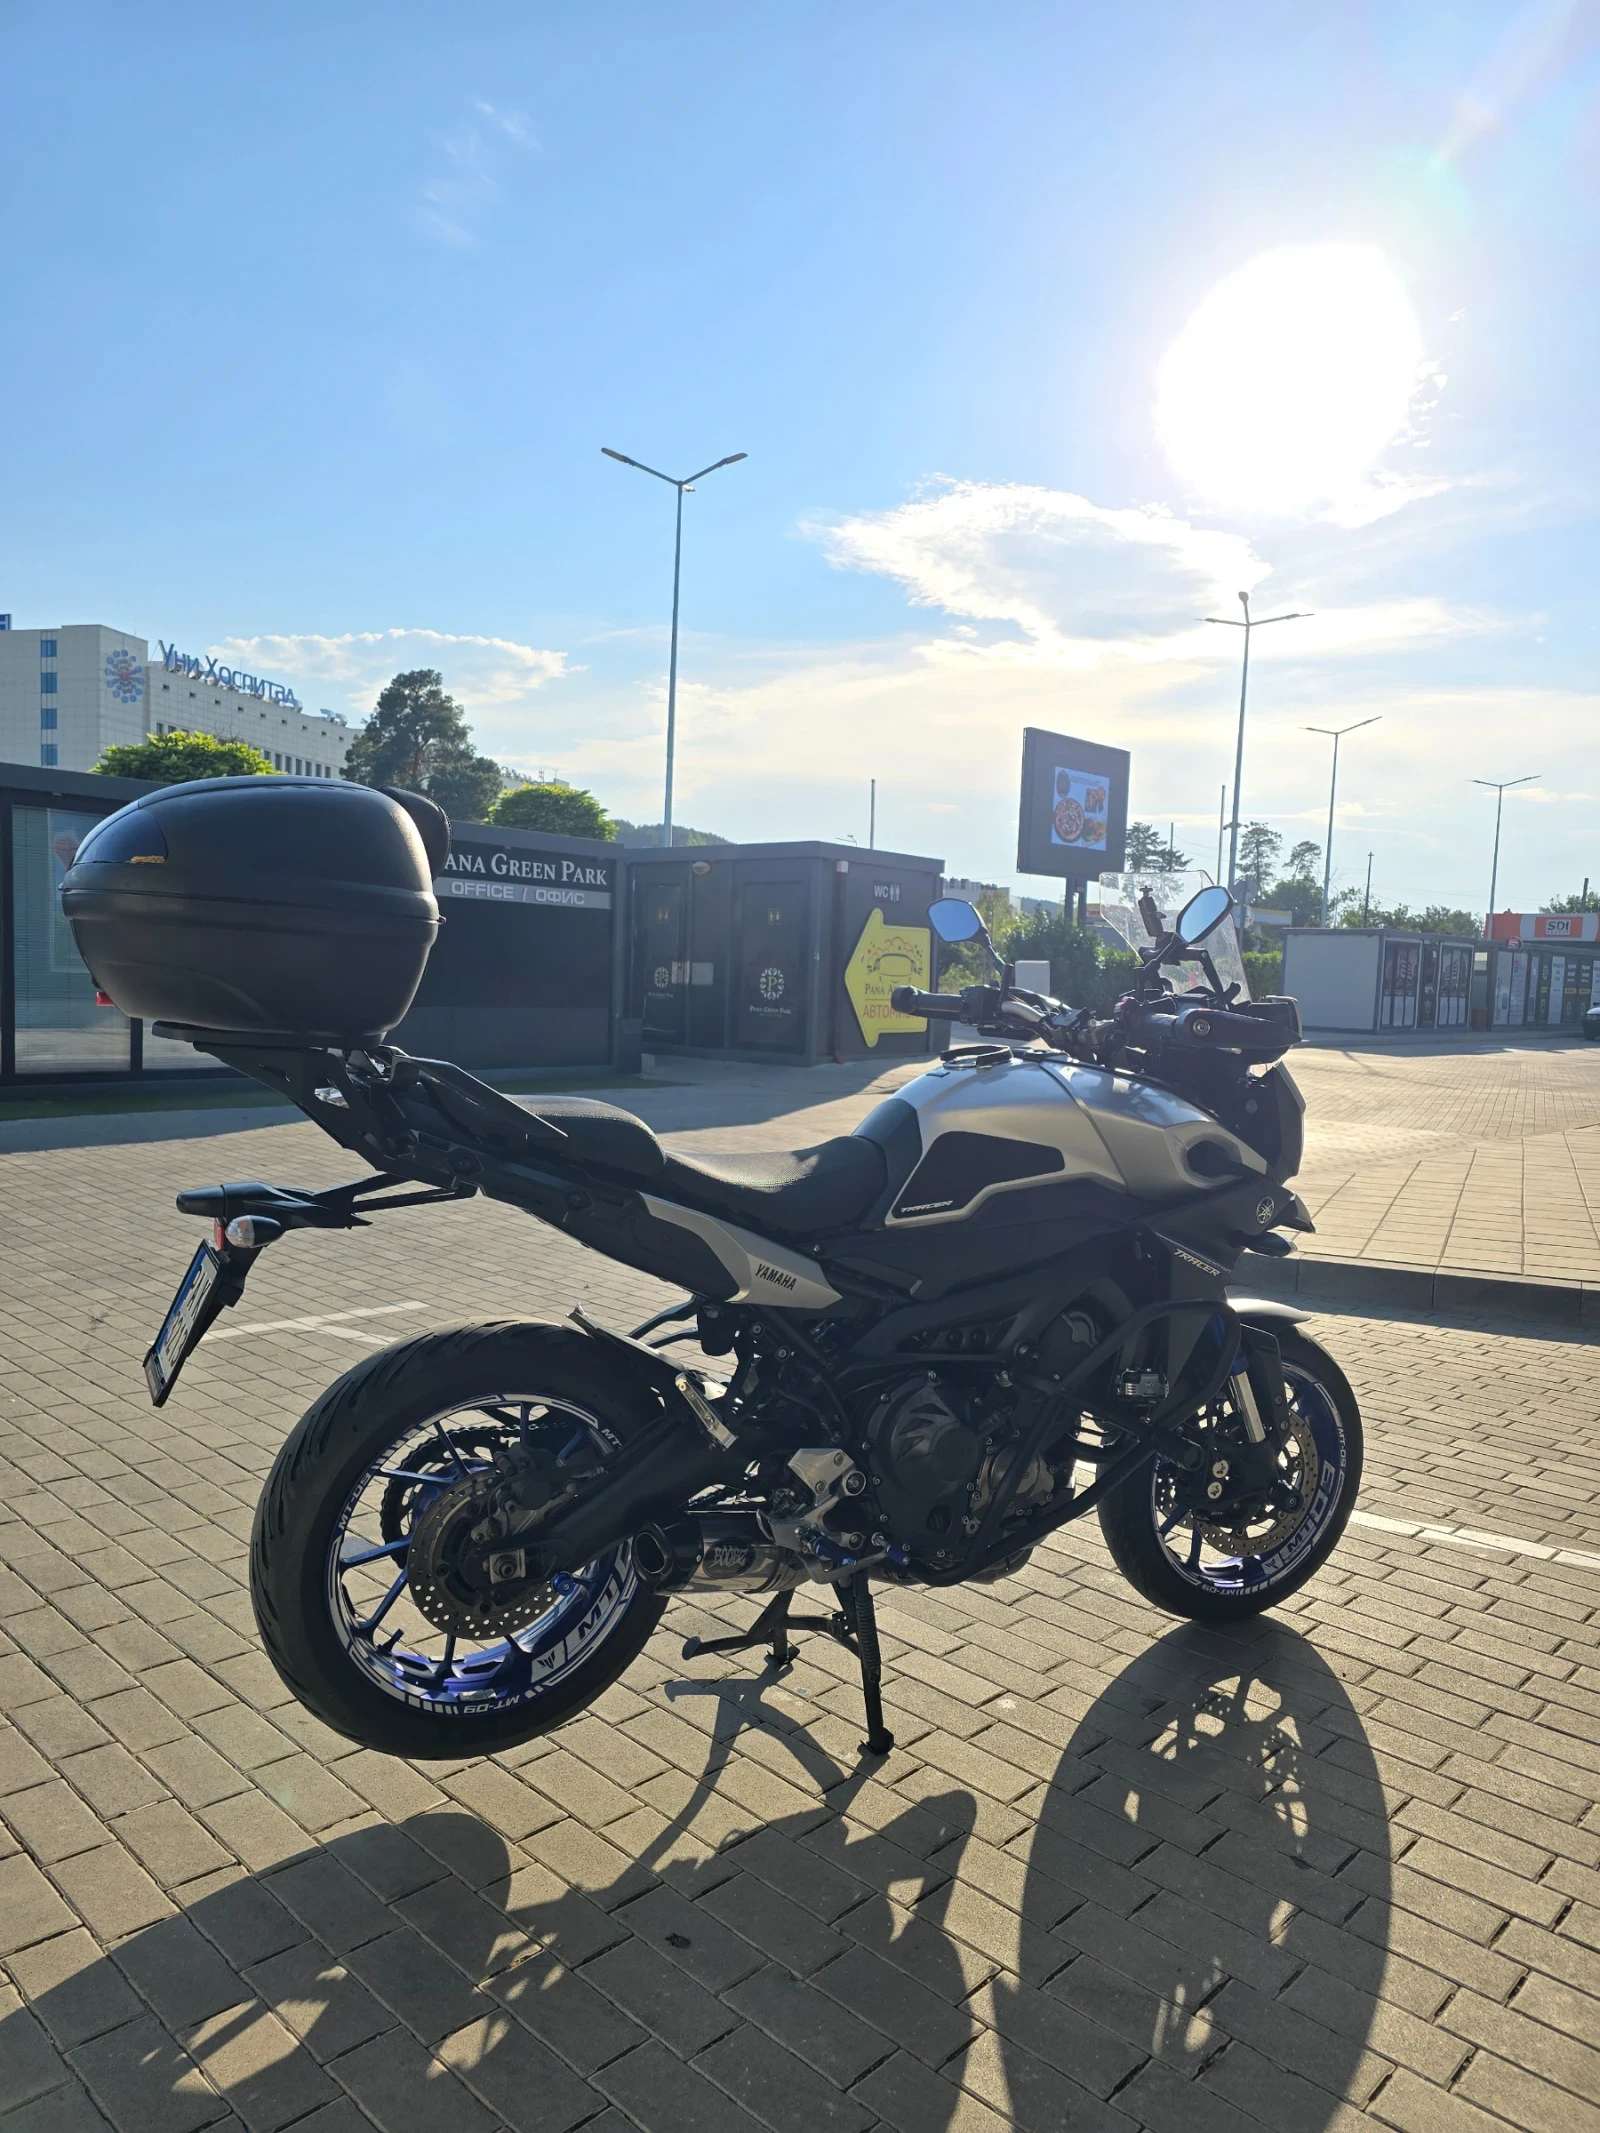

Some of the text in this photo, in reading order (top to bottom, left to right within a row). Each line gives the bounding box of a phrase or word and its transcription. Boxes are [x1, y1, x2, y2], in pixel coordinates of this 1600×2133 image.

[443, 853, 607, 886] ANA GREEN PARK
[451, 881, 514, 899] OFFICE
[535, 889, 585, 906] ОФИС
[874, 884, 889, 898] WC
[1547, 921, 1570, 931] SDI
[1173, 1248, 1221, 1277] TRACER
[755, 1263, 797, 1290] YAMAHA
[600, 1428, 623, 1449] MT-
[338, 1472, 372, 1530] MT-09
[463, 1694, 520, 1714] MT-09
